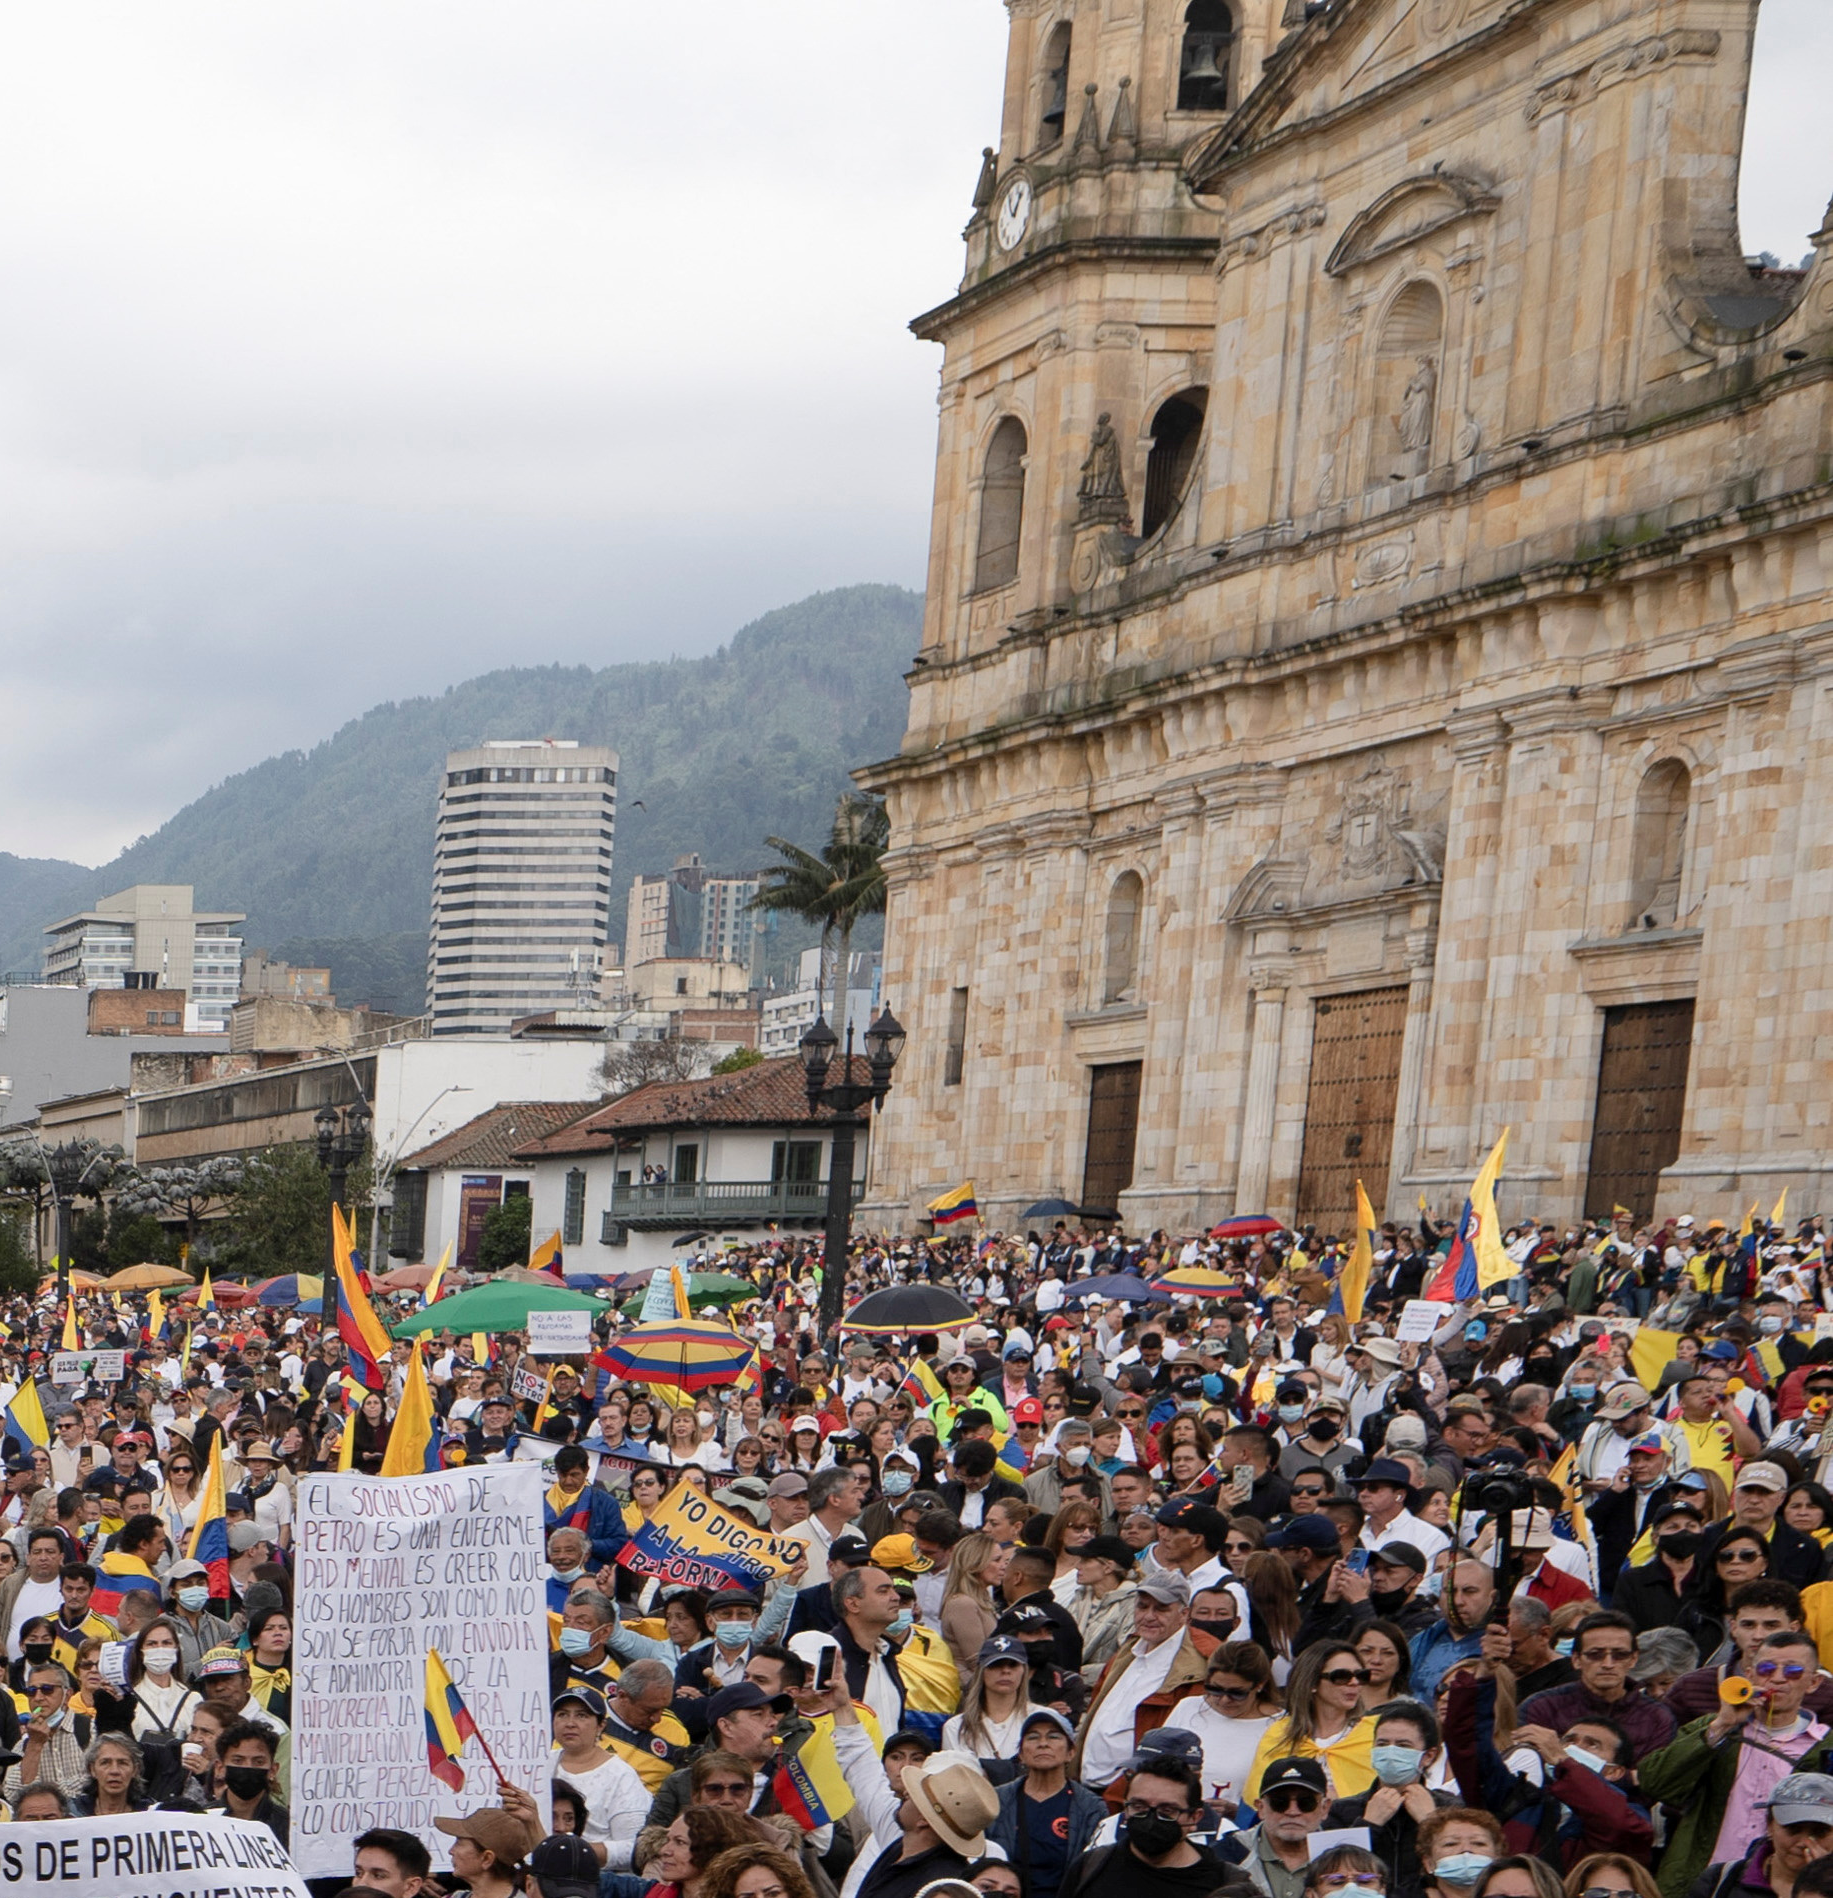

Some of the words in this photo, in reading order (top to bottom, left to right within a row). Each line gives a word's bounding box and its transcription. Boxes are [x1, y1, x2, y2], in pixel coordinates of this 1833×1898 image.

[557, 1314, 573, 1322] LAS
[56, 1366, 79, 1374] PAGA
[513, 1382, 545, 1402] PETRO
[308, 1484, 338, 1517] EL
[468, 1476, 496, 1513] DE
[677, 1488, 710, 1524] YO
[302, 1519, 367, 1553] PETRO
[373, 1519, 402, 1552] ES
[409, 1520, 441, 1550] UNA
[647, 1522, 670, 1547] A
[665, 1534, 700, 1559] LA
[303, 1557, 339, 1590] DAD
[344, 1556, 411, 1590] MENTAL
[413, 1554, 435, 1585] ES
[444, 1551, 500, 1585] CREER
[509, 1550, 545, 1584] QUE
[301, 1592, 334, 1624] LOS
[338, 1590, 413, 1624] HOMBRES
[418, 1589, 451, 1620] SON
[454, 1587, 498, 1618] COMO
[505, 1585, 536, 1616] NO
[341, 1627, 365, 1659] SE
[368, 1625, 417, 1657] FORJA
[299, 1664, 321, 1694] SE
[486, 1656, 511, 1689] LA
[398, 1691, 418, 1727] LA
[519, 1689, 544, 1724] LA
[300, 1766, 369, 1801] GENERE
[301, 1803, 325, 1835] LO
[330, 1799, 440, 1834] CONSTRUIDO
[35, 1839, 82, 1882] DE
[91, 1830, 222, 1879] PRIMERA
[222, 1824, 299, 1874] LÍNEA
